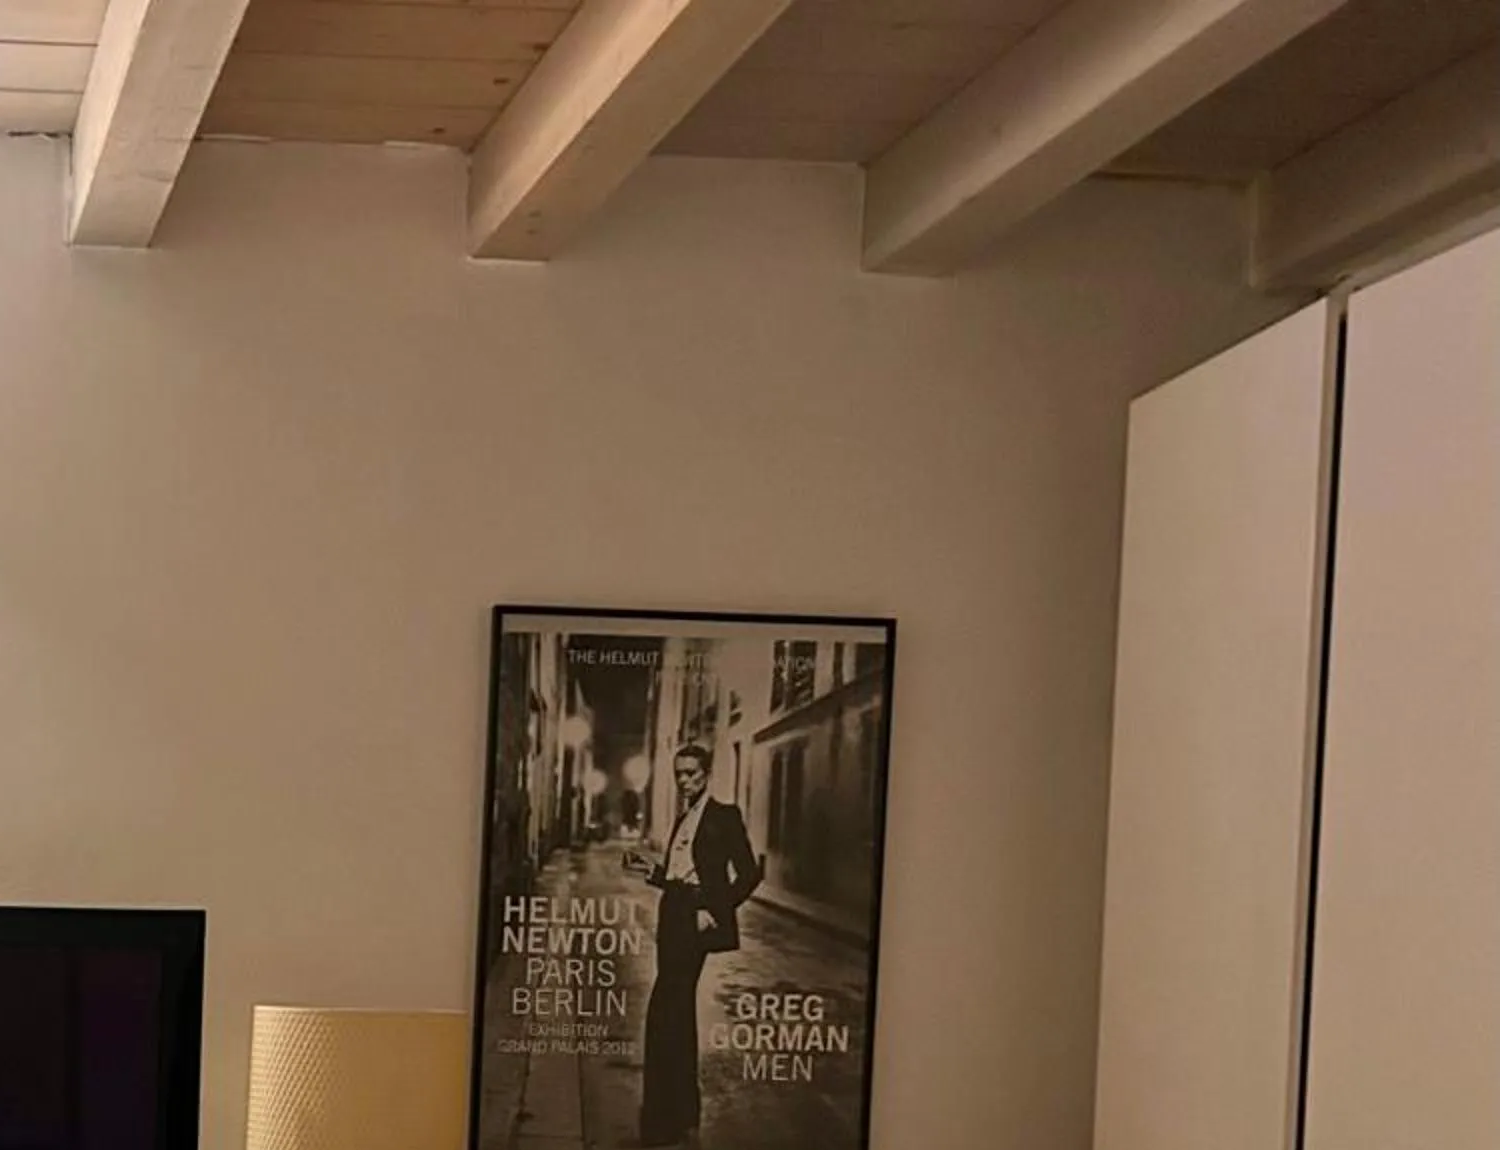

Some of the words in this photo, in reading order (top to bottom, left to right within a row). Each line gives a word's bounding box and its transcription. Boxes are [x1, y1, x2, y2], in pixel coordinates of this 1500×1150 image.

[569, 650, 596, 665] THE
[599, 650, 660, 666] HELMUT
[503, 896, 640, 925] HELMUT
[502, 926, 643, 955] NEWTON
[526, 957, 616, 987] PARIS
[512, 987, 627, 1017] BERLIN
[736, 993, 824, 1021] GREG
[551, 1039, 599, 1055] PALAIS
[709, 1023, 849, 1053] GORMAN
[742, 1053, 813, 1081] MEN
